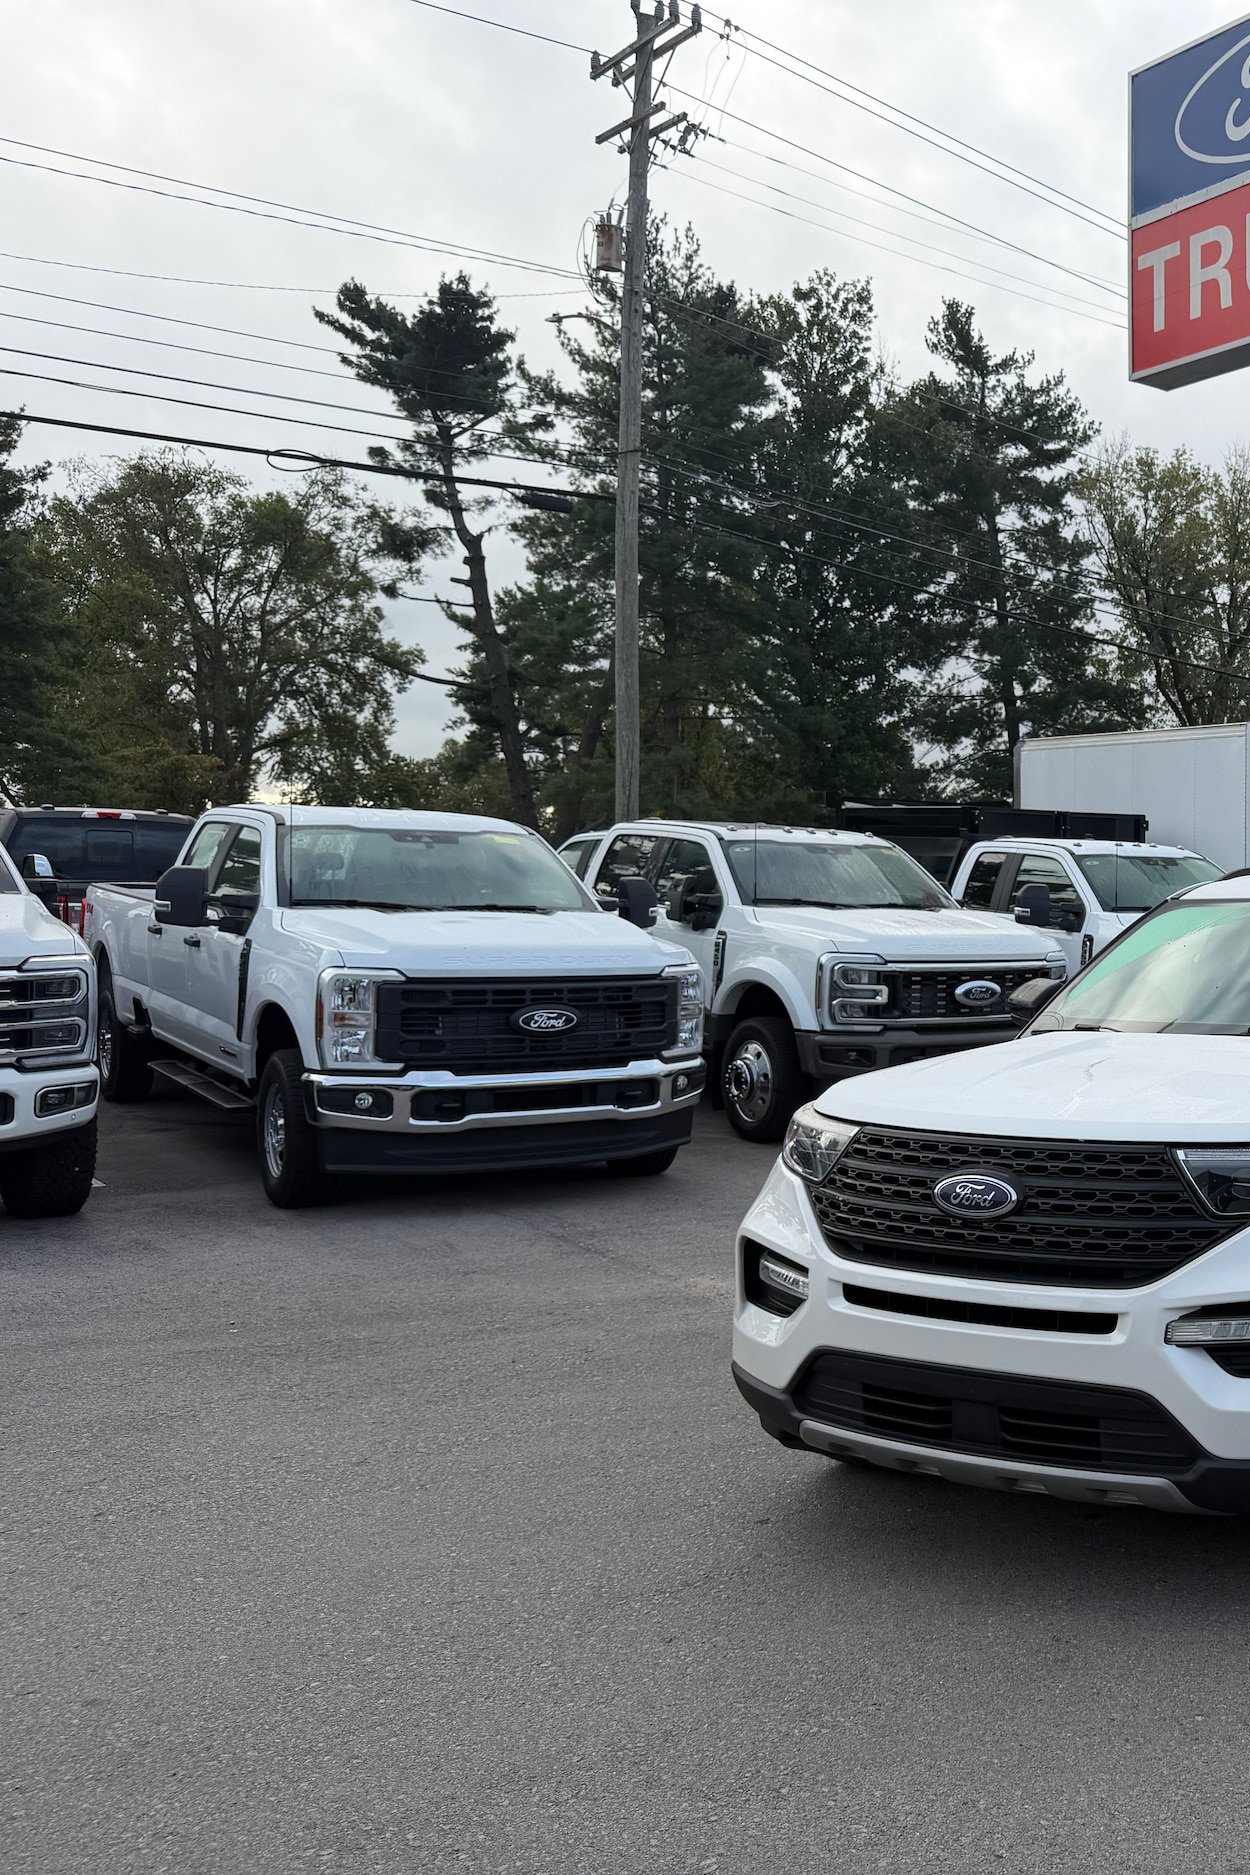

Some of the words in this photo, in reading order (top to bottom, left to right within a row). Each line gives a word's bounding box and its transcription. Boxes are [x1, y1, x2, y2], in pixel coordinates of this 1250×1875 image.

[443, 955, 550, 966] SUPER
[970, 987, 992, 1000] Ford
[530, 1012, 567, 1028] Ford
[950, 1182, 996, 1208] Ford
